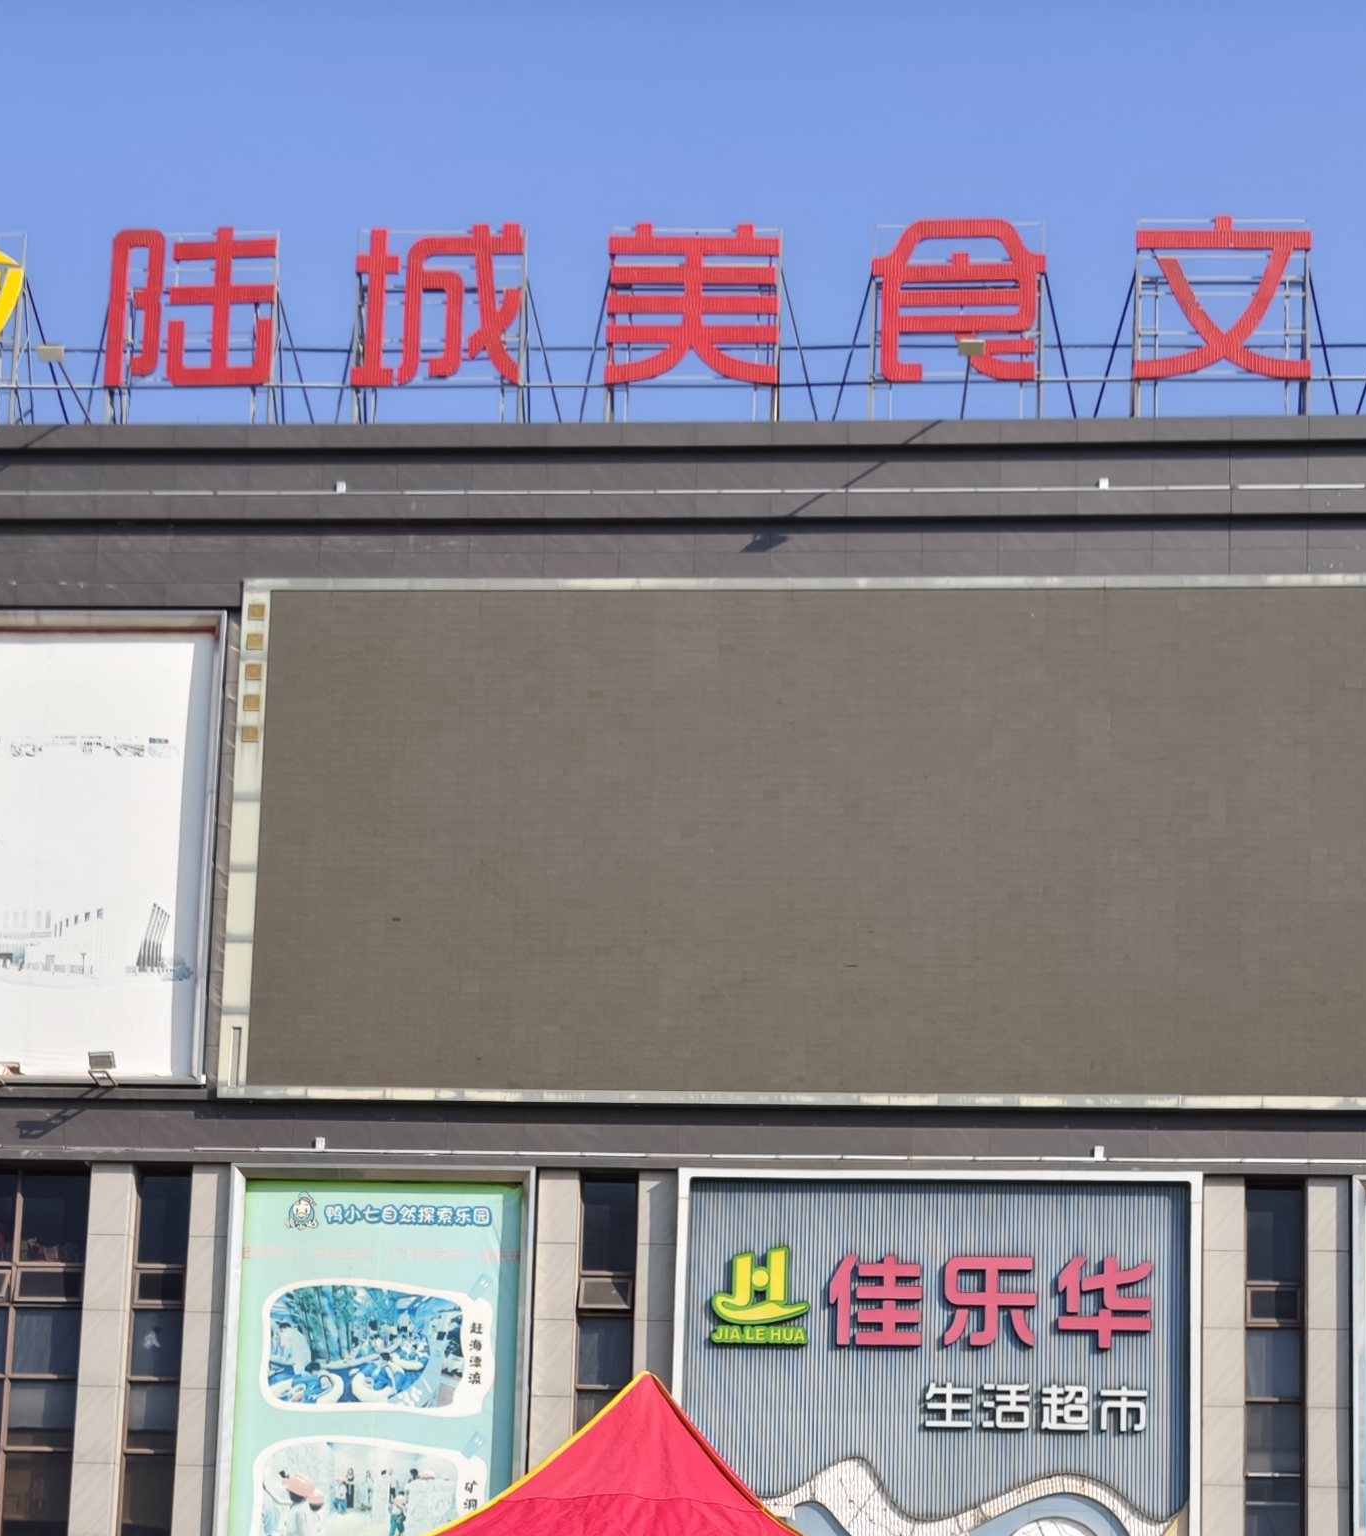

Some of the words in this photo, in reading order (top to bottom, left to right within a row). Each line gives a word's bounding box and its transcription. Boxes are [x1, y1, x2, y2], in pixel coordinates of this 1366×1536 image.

[324, 1203, 492, 1227] 鸭小七自然探索乐园
[829, 1253, 1153, 1350] 佳乐华
[467, 1321, 484, 1387] 赶海漂流
[713, 1327, 742, 1344] JIA
[744, 1327, 768, 1344] LE
[770, 1327, 807, 1344] HUA
[924, 1382, 1148, 1433] 生活超市
